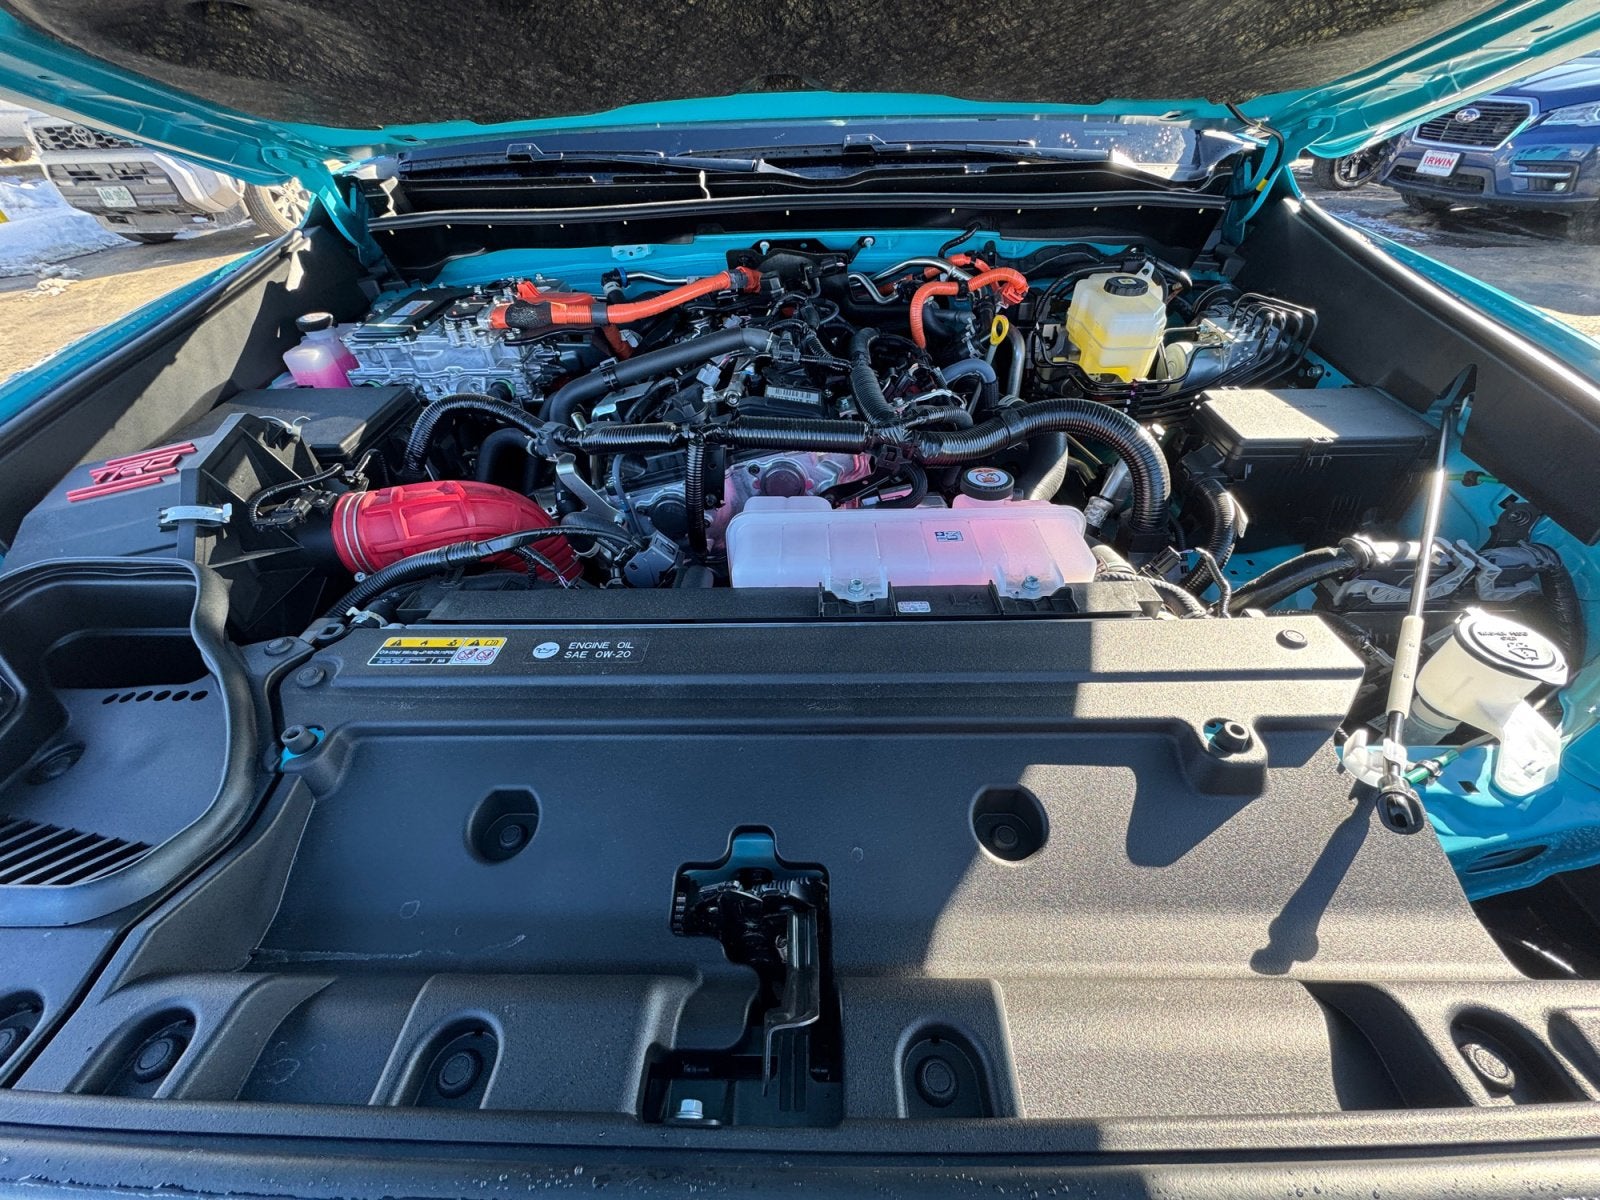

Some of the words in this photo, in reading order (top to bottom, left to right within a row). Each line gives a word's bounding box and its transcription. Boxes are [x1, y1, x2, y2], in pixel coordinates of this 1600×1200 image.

[1424, 156, 1455, 168] IRWIN
[568, 641, 611, 650] ENGINE
[616, 641, 634, 650] OIL
[564, 650, 589, 659] SAE
[595, 650, 631, 659] 0W-20
